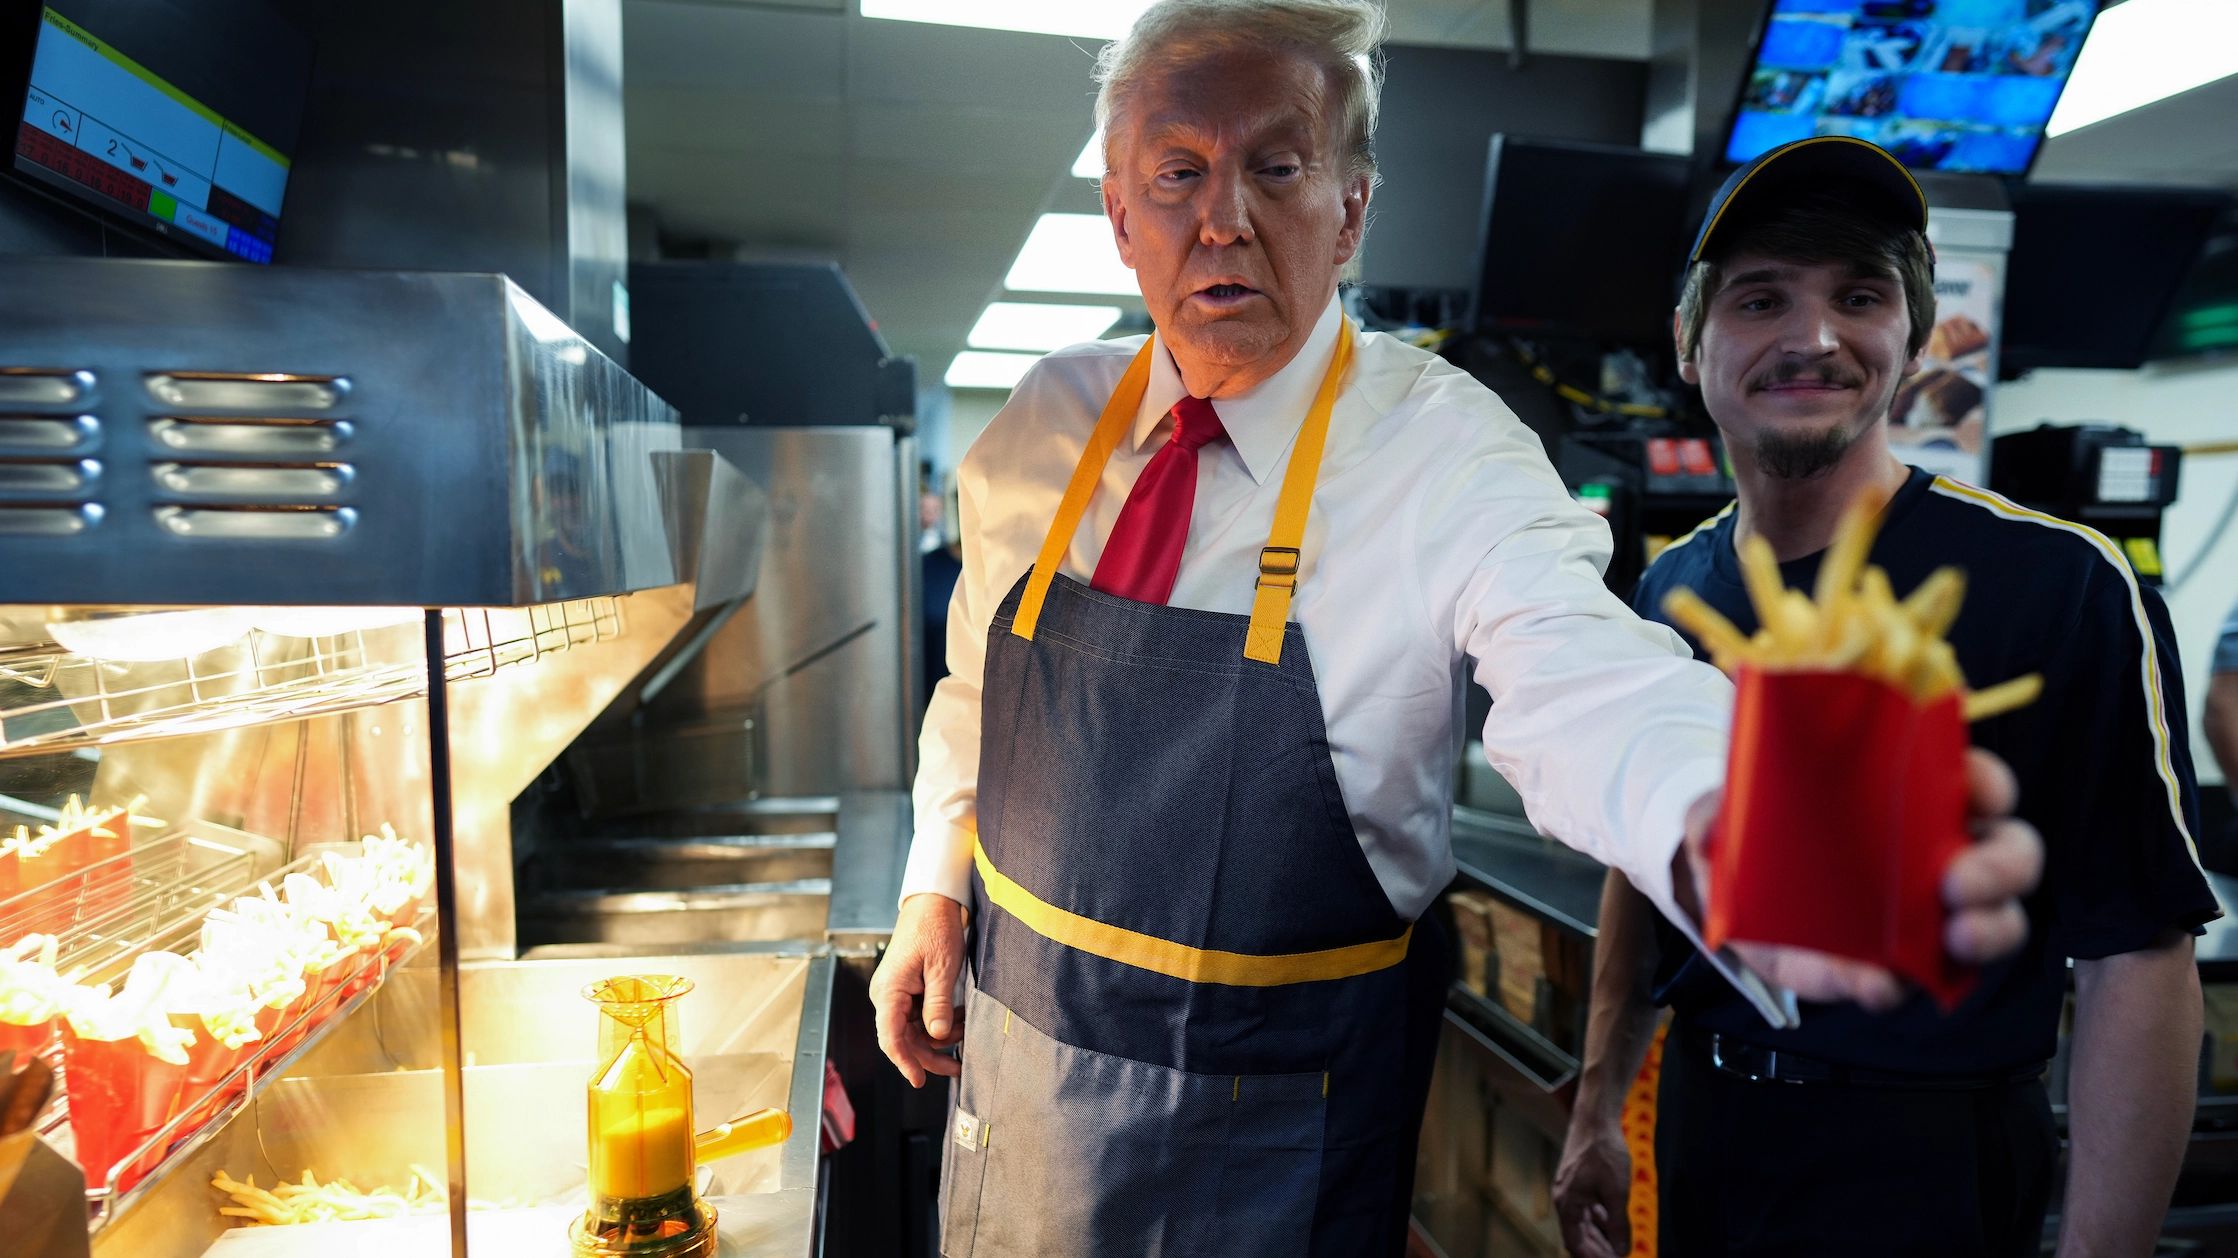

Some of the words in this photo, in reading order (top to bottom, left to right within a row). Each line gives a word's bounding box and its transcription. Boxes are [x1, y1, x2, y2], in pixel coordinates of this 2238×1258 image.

[45, 11, 99, 52] Fries-Summary
[29, 93, 45, 105] AUTO
[107, 138, 118, 157] 2
[42, 153, 48, 164] 0
[76, 168, 82, 180] 0
